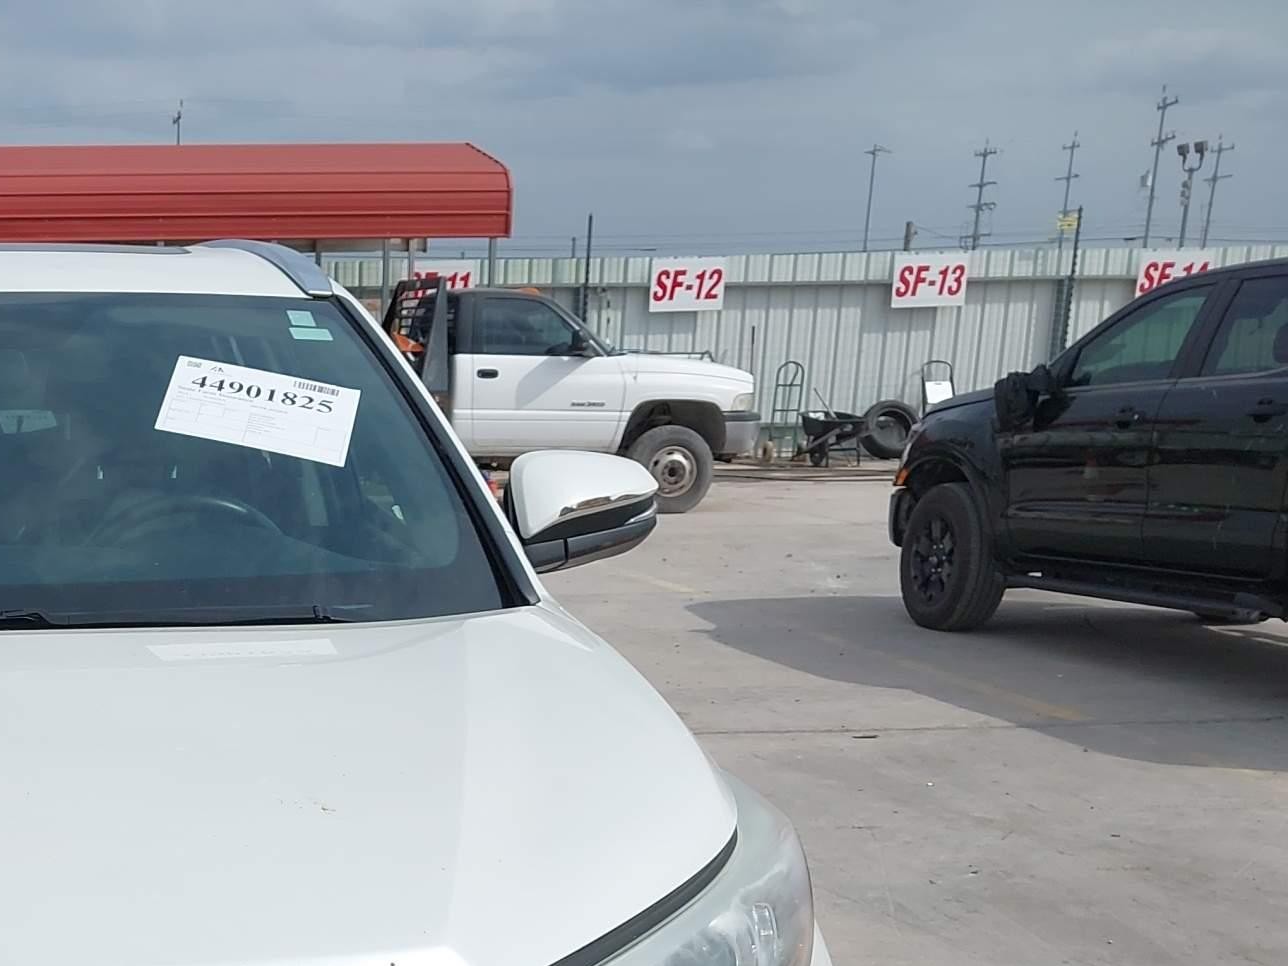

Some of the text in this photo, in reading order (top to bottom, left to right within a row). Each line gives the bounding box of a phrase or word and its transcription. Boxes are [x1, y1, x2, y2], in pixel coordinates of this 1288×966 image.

[652, 268, 723, 302] SF-12
[895, 264, 965, 298] SF-13
[191, 375, 335, 414] 44901825
